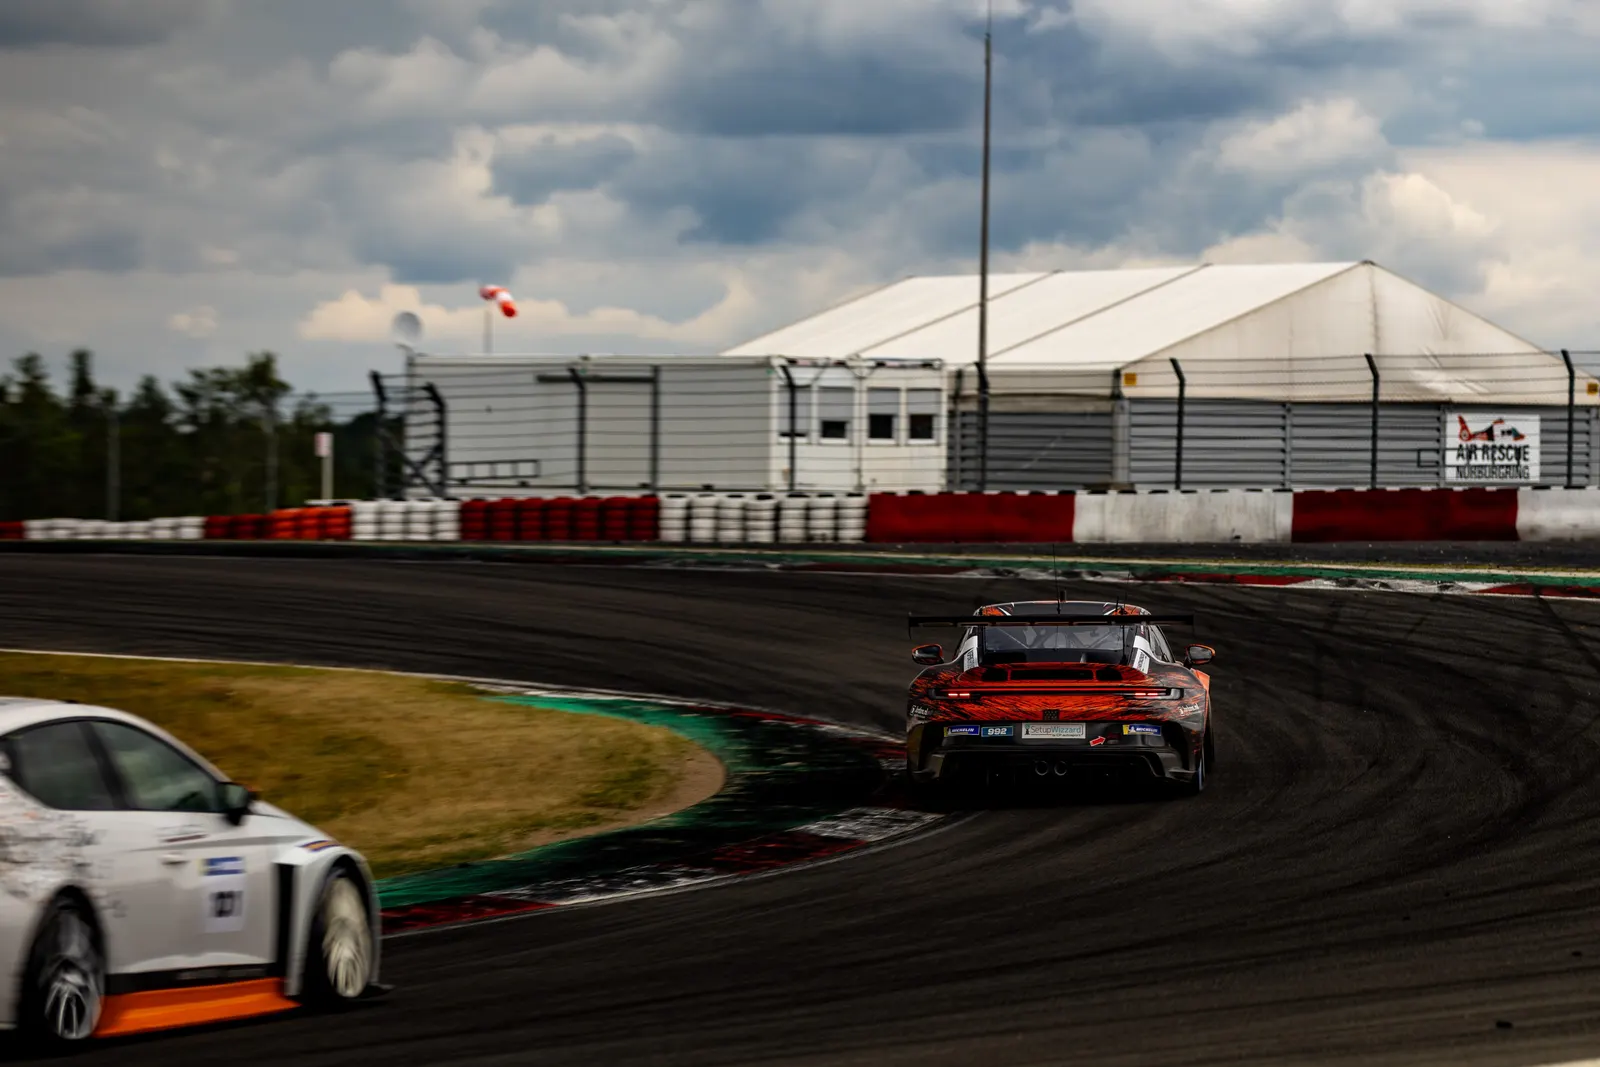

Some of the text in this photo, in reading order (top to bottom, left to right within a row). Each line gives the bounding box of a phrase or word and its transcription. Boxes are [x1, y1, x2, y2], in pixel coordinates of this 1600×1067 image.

[1456, 444, 1529, 461] AIR RESCUE
[1030, 725, 1081, 735] SetupWizzard
